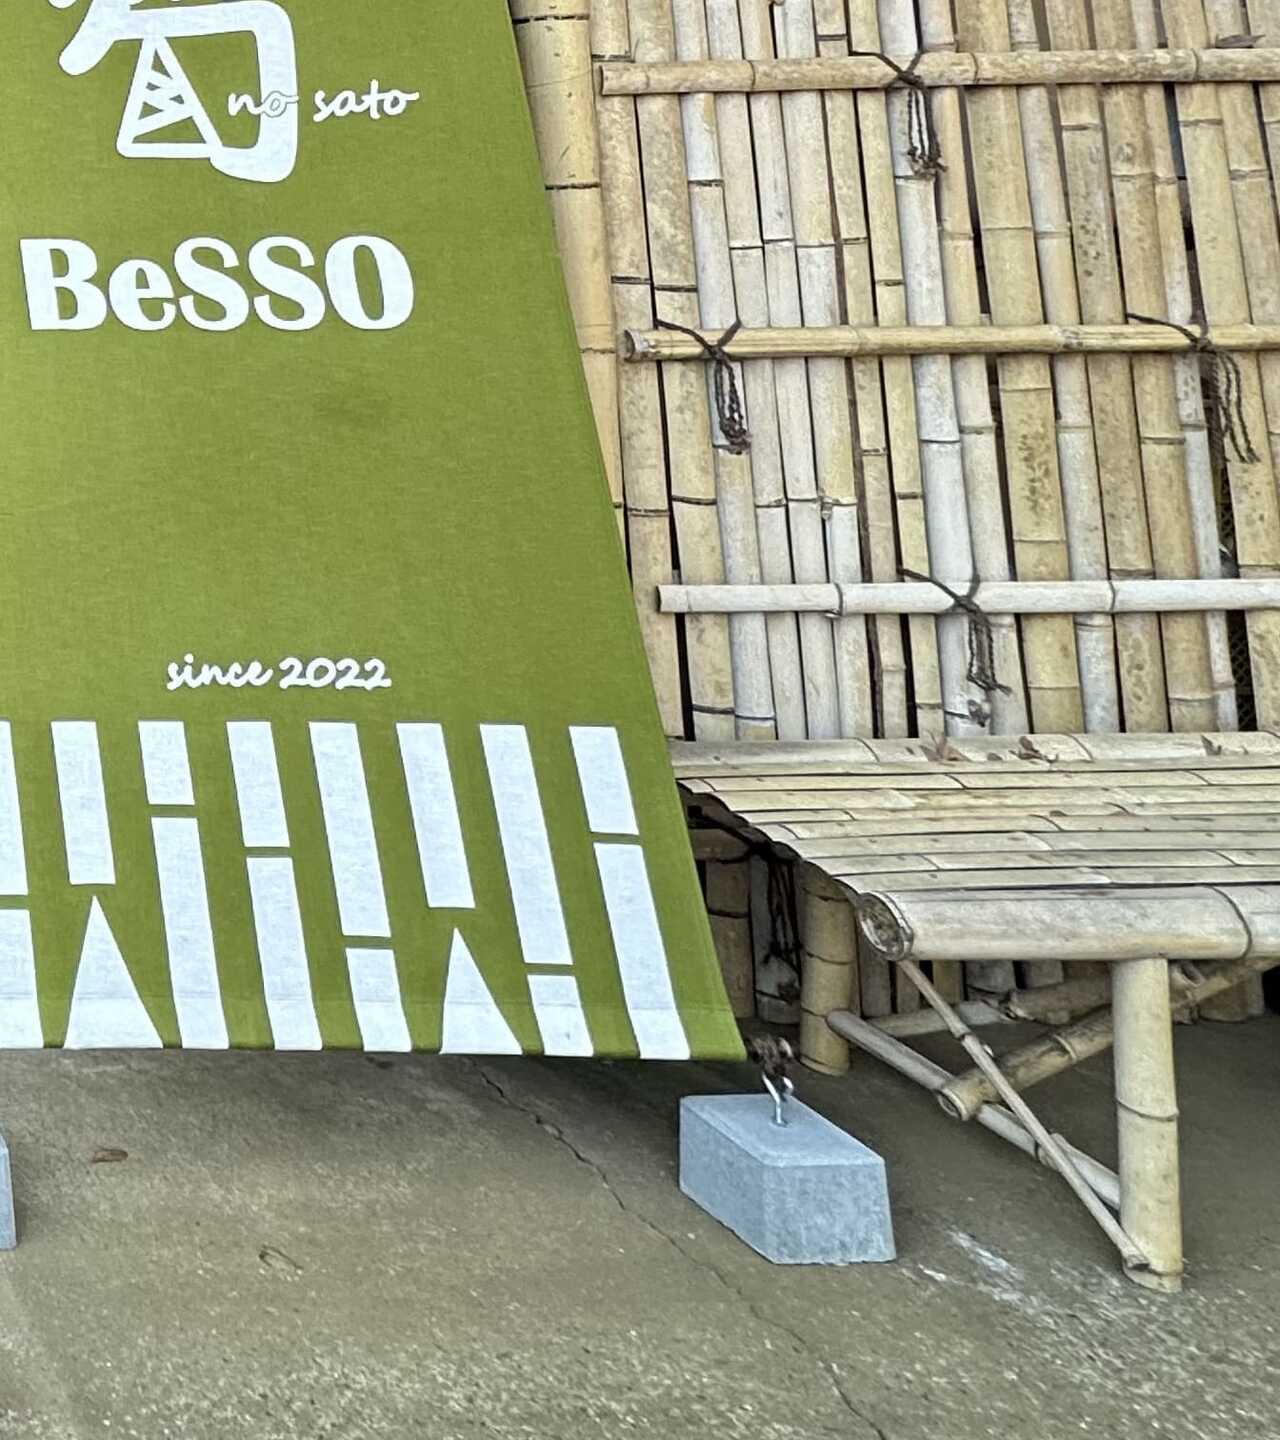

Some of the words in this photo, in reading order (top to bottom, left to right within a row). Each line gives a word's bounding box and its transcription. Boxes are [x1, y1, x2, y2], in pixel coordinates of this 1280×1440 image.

[228, 90, 300, 118] no
[313, 79, 420, 122] sato
[166, 652, 274, 691] since
[278, 656, 393, 691] 2022
